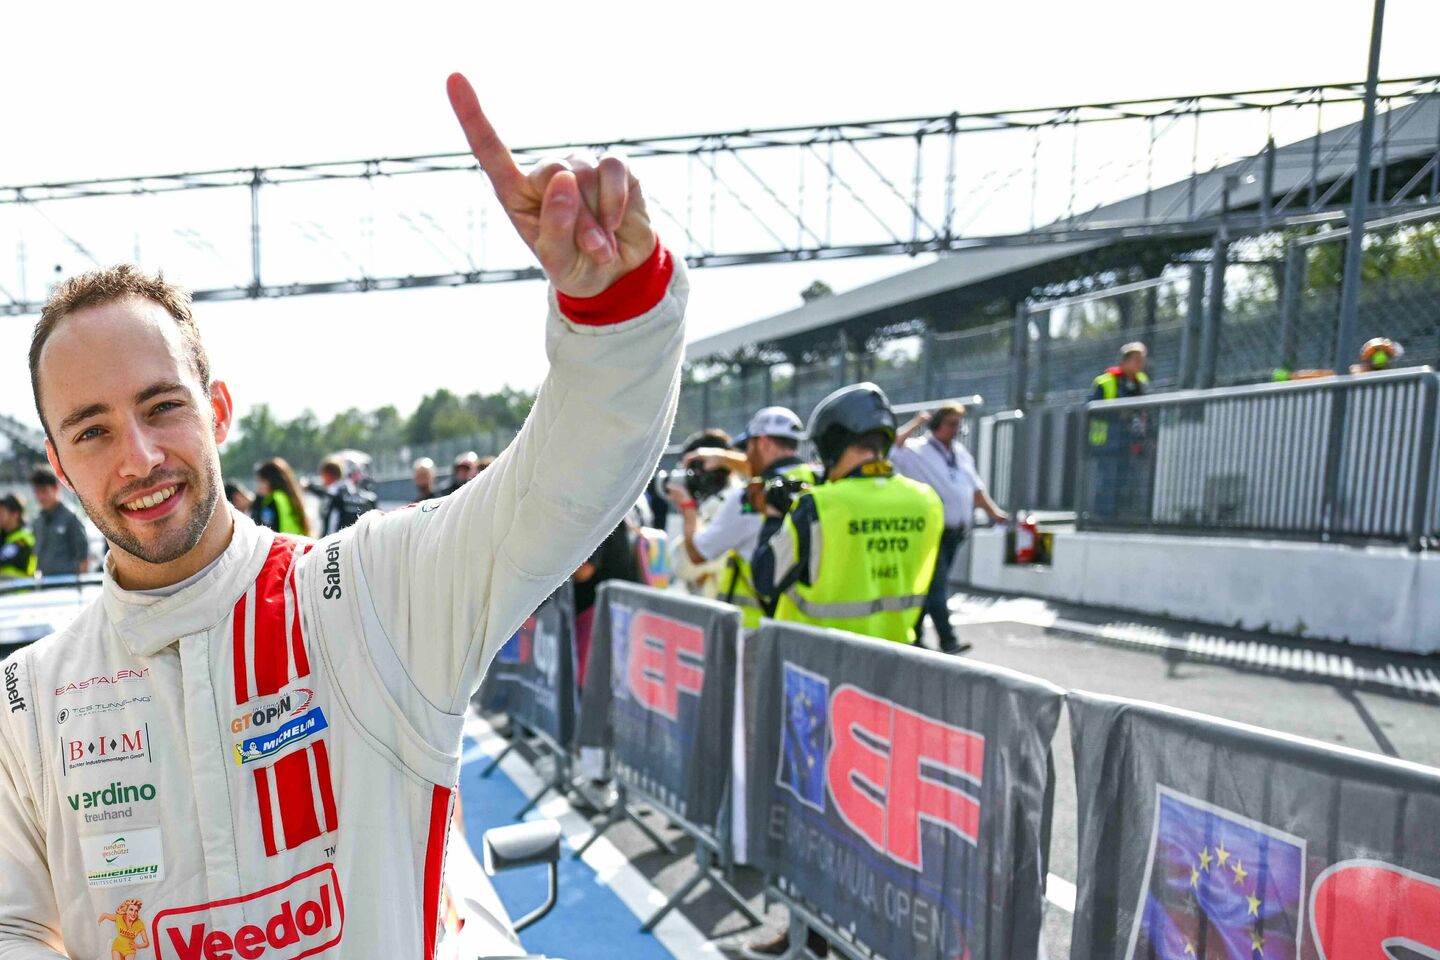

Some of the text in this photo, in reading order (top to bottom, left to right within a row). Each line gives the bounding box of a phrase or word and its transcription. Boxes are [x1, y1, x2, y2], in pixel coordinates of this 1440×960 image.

[848, 516, 926, 535] SERVIZIO
[866, 537, 909, 553] FOTO
[628, 609, 705, 722] EF
[5, 662, 27, 713] Sabelt
[263, 718, 315, 751] MICHELIN
[827, 682, 985, 873] EF
[67, 782, 157, 811] verdino
[85, 807, 133, 823] treuhand
